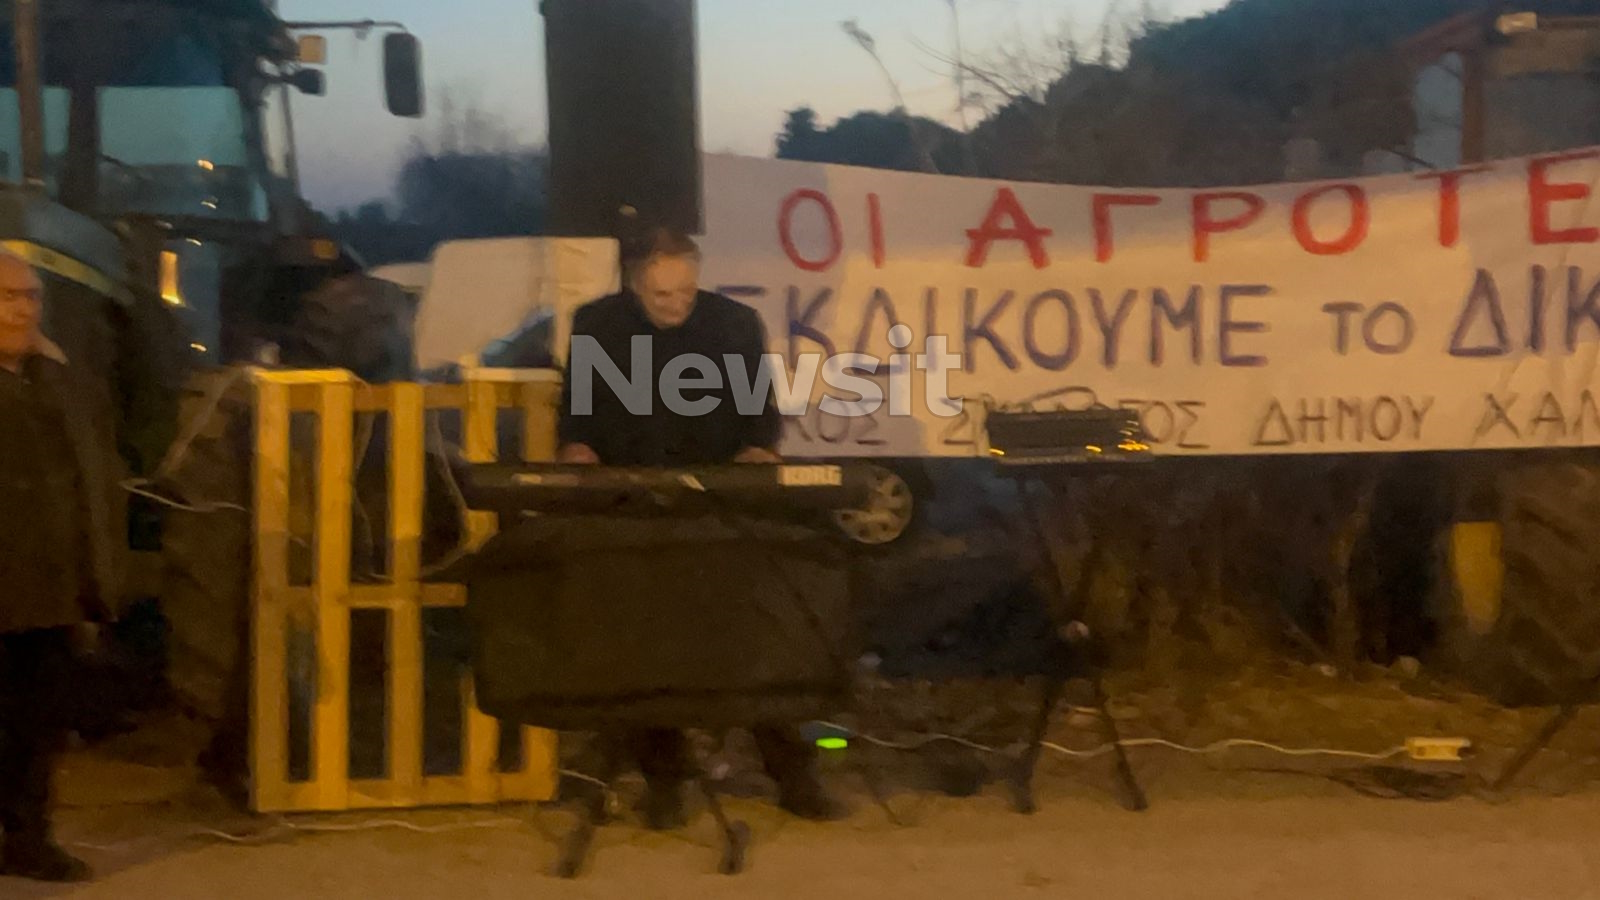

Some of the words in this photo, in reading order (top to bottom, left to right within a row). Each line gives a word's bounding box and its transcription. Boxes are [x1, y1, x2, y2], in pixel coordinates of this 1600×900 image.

[777, 187, 887, 272] ΟΙ
[964, 150, 1600, 269] ΑΓΡΟΤΕ
[717, 283, 1273, 375] ΚΔΙΚΟΥΜΕ
[1449, 263, 1600, 357] ΔΙΚ
[1253, 394, 1435, 447] ΔΗΜΟΥ
